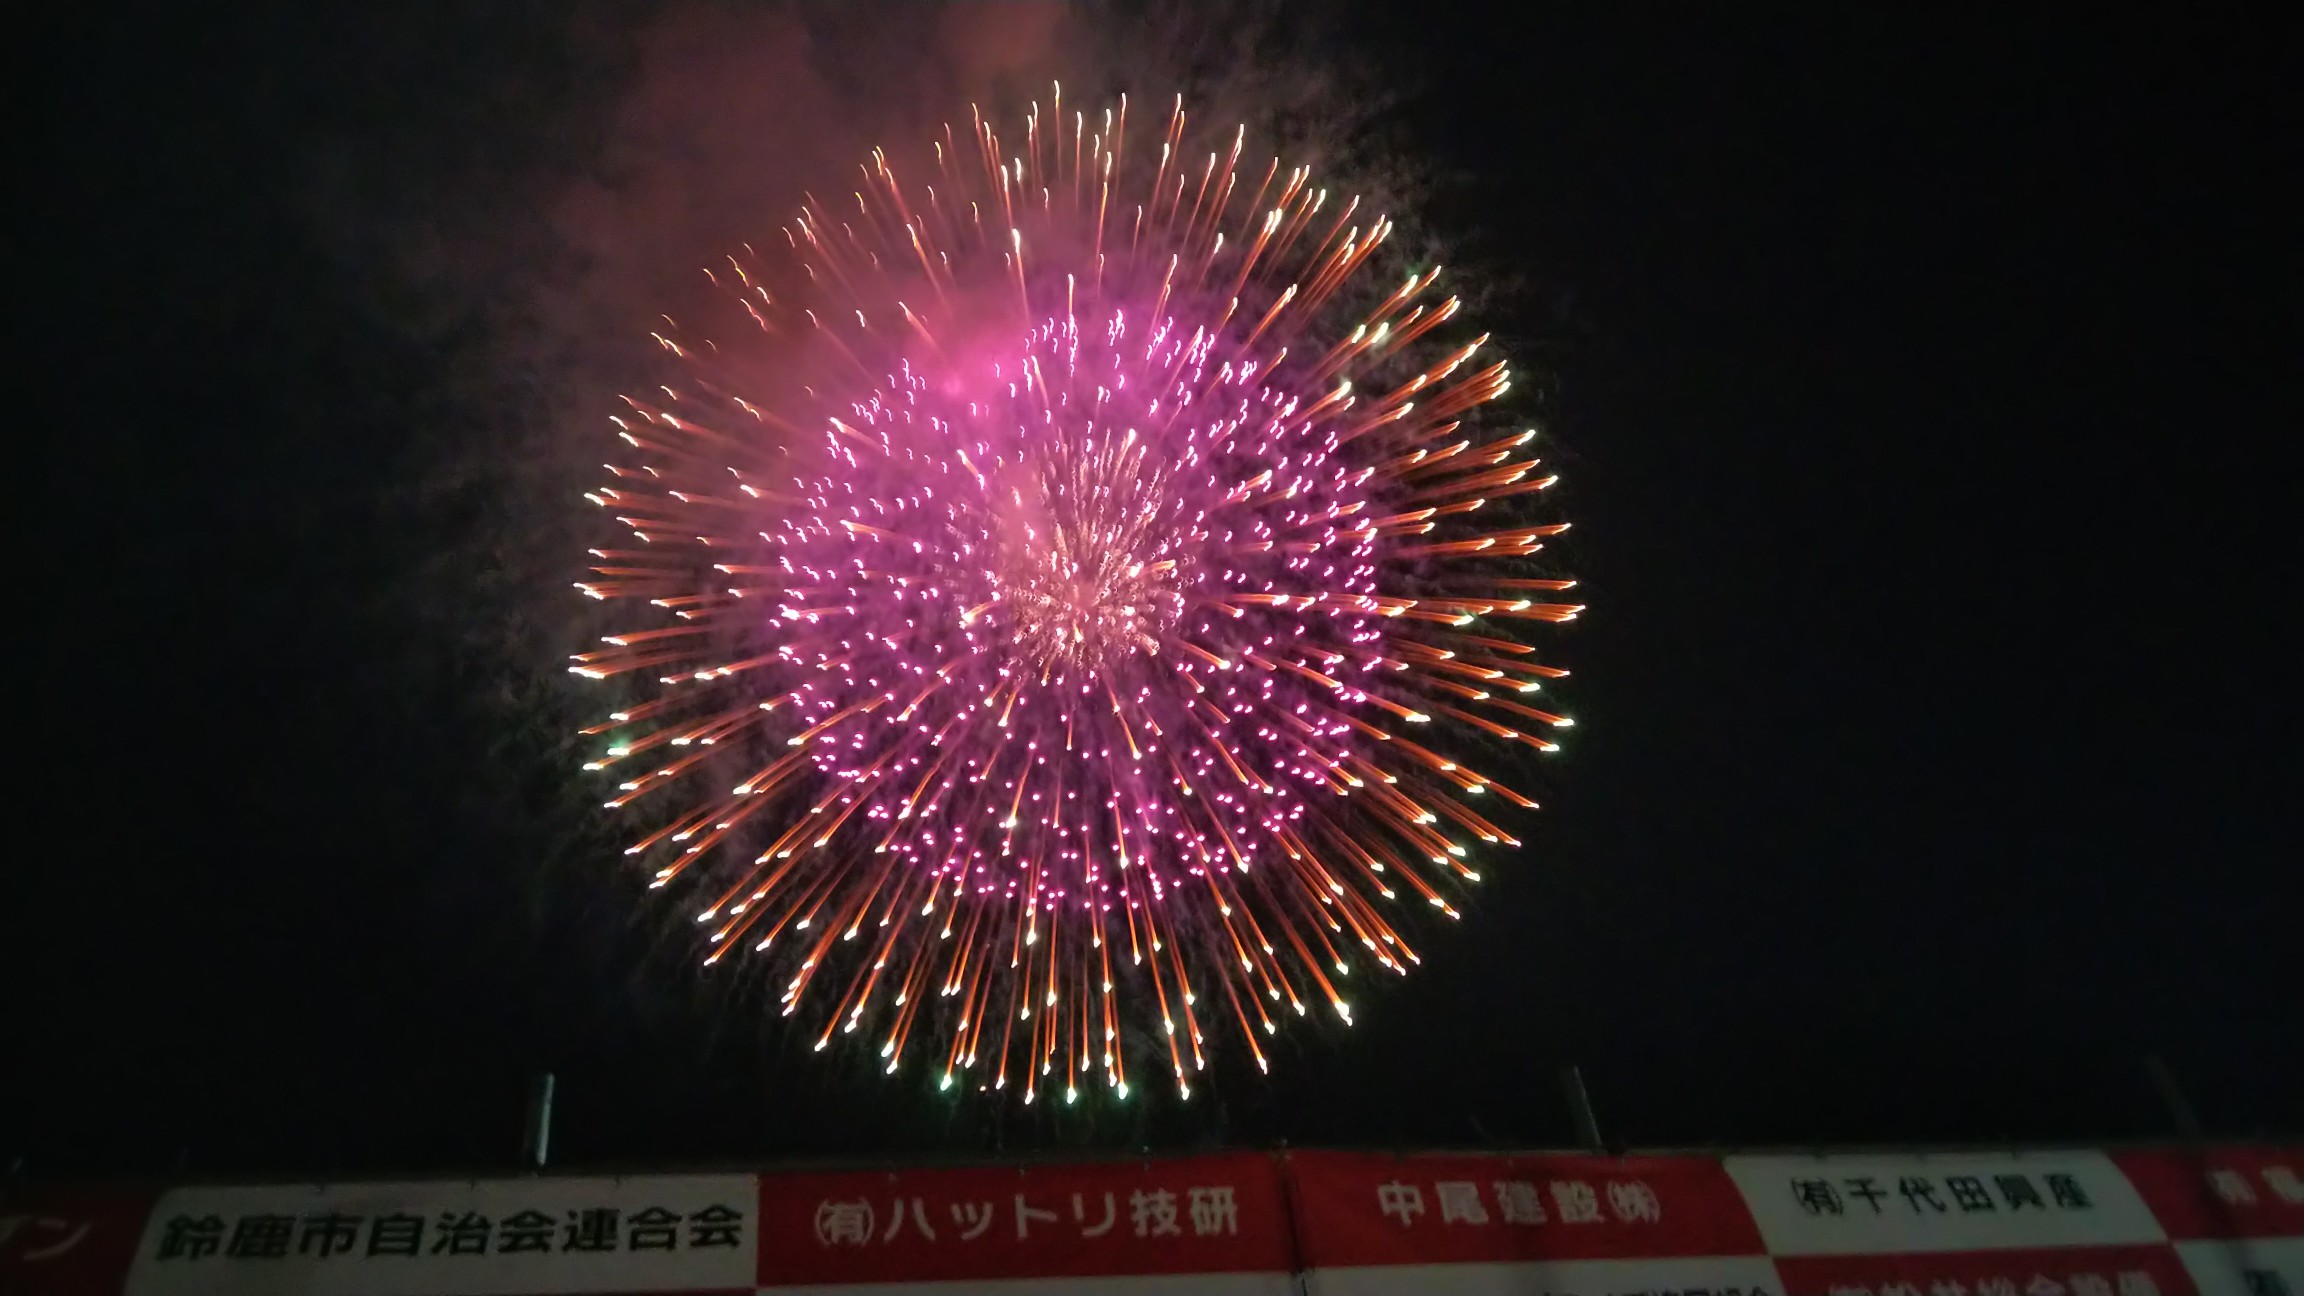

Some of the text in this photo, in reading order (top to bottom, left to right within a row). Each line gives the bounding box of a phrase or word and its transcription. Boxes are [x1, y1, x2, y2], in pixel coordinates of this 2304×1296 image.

[155, 1204, 744, 1262] 鈴鹿市自治会連合会
